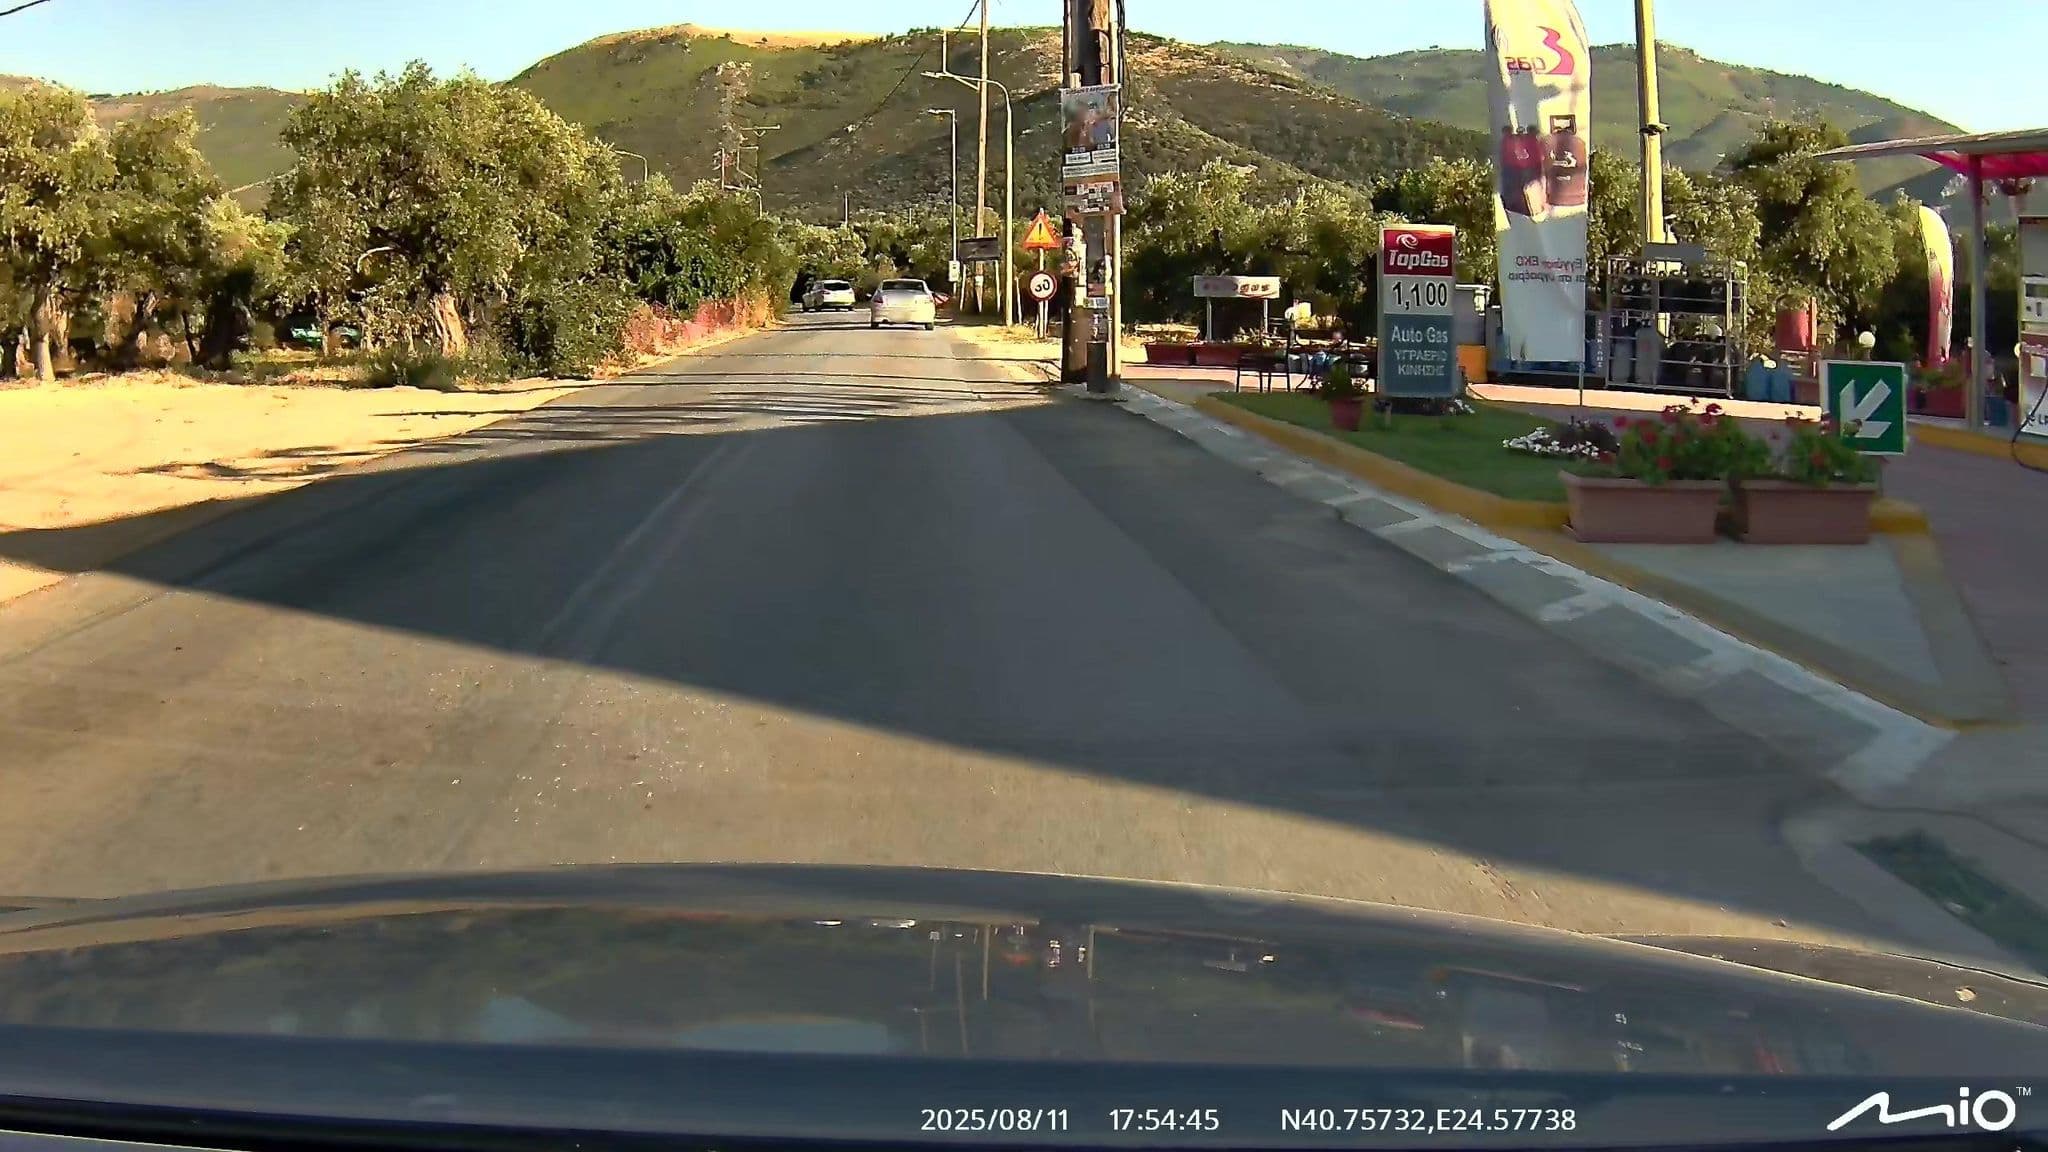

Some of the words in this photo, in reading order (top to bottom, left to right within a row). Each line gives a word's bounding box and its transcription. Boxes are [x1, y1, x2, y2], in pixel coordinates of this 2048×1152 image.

[1389, 249, 1449, 270] TopGas
[1392, 281, 1448, 311] 1,100
[1391, 325, 1424, 343] Auto
[1426, 326, 1449, 344] Gas
